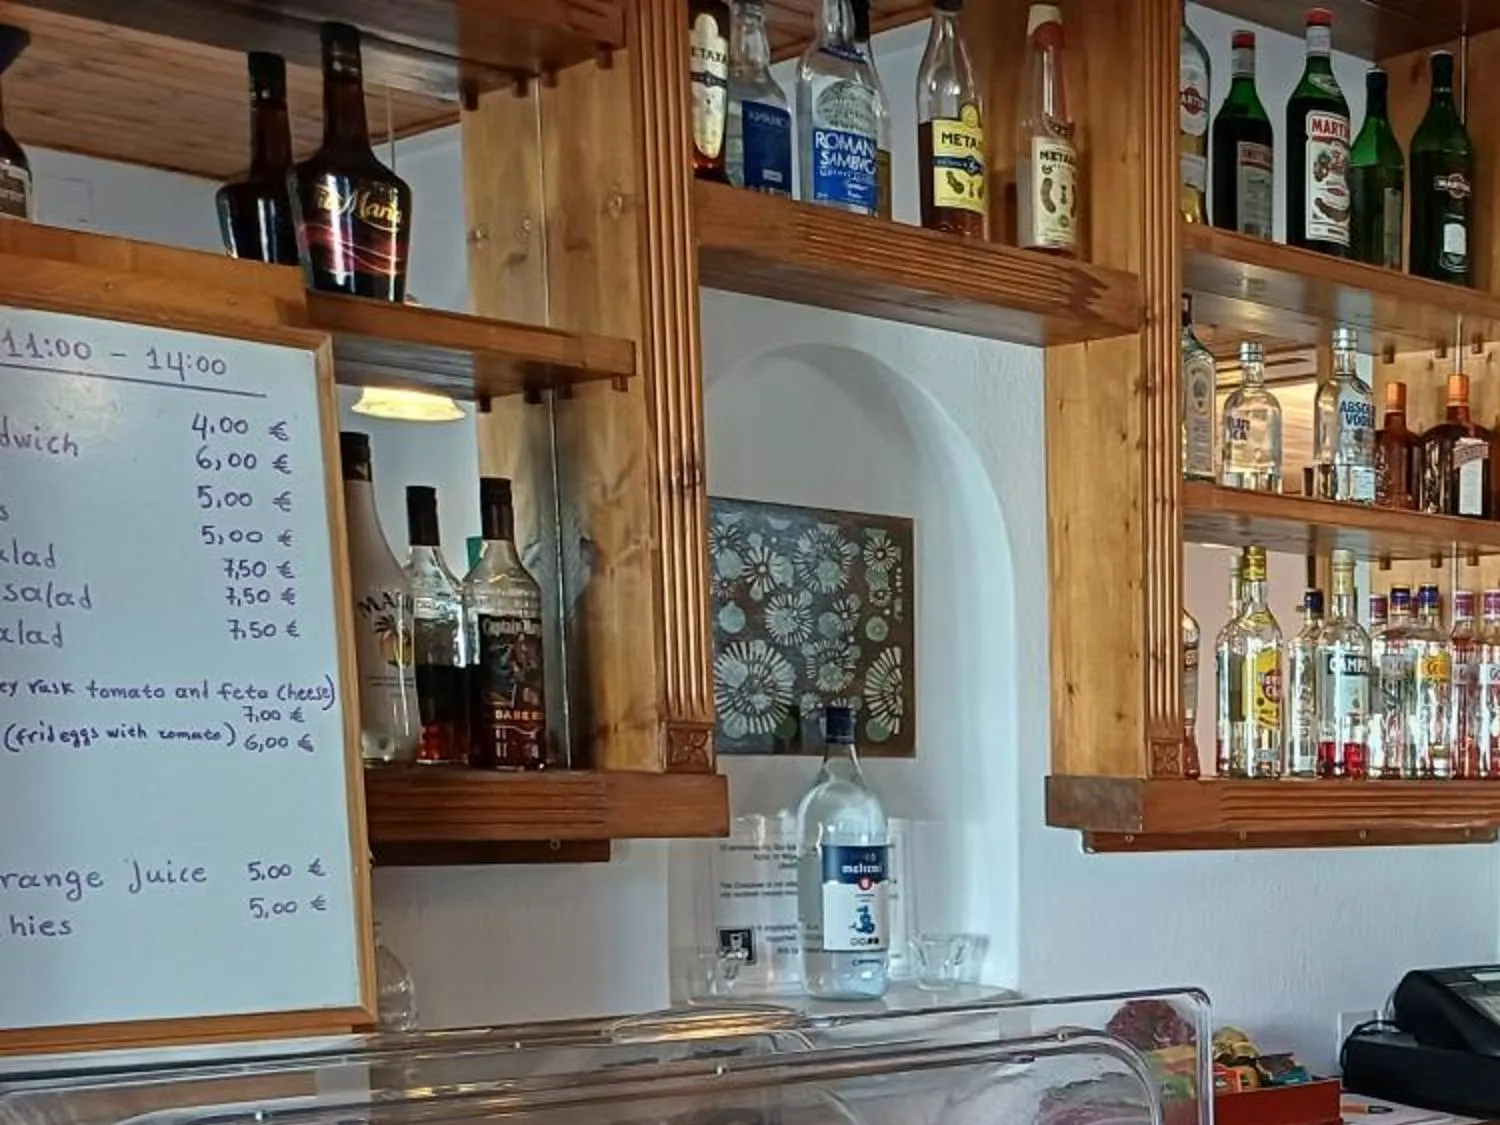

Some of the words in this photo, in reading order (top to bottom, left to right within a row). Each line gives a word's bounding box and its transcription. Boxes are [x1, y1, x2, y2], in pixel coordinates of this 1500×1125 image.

[2, 329, 92, 360] 11:00
[147, 346, 227, 382] 14:00
[3, 581, 92, 609] salad
[86, 679, 165, 699] tomato
[60, 727, 99, 748] eggs
[106, 723, 148, 739] with
